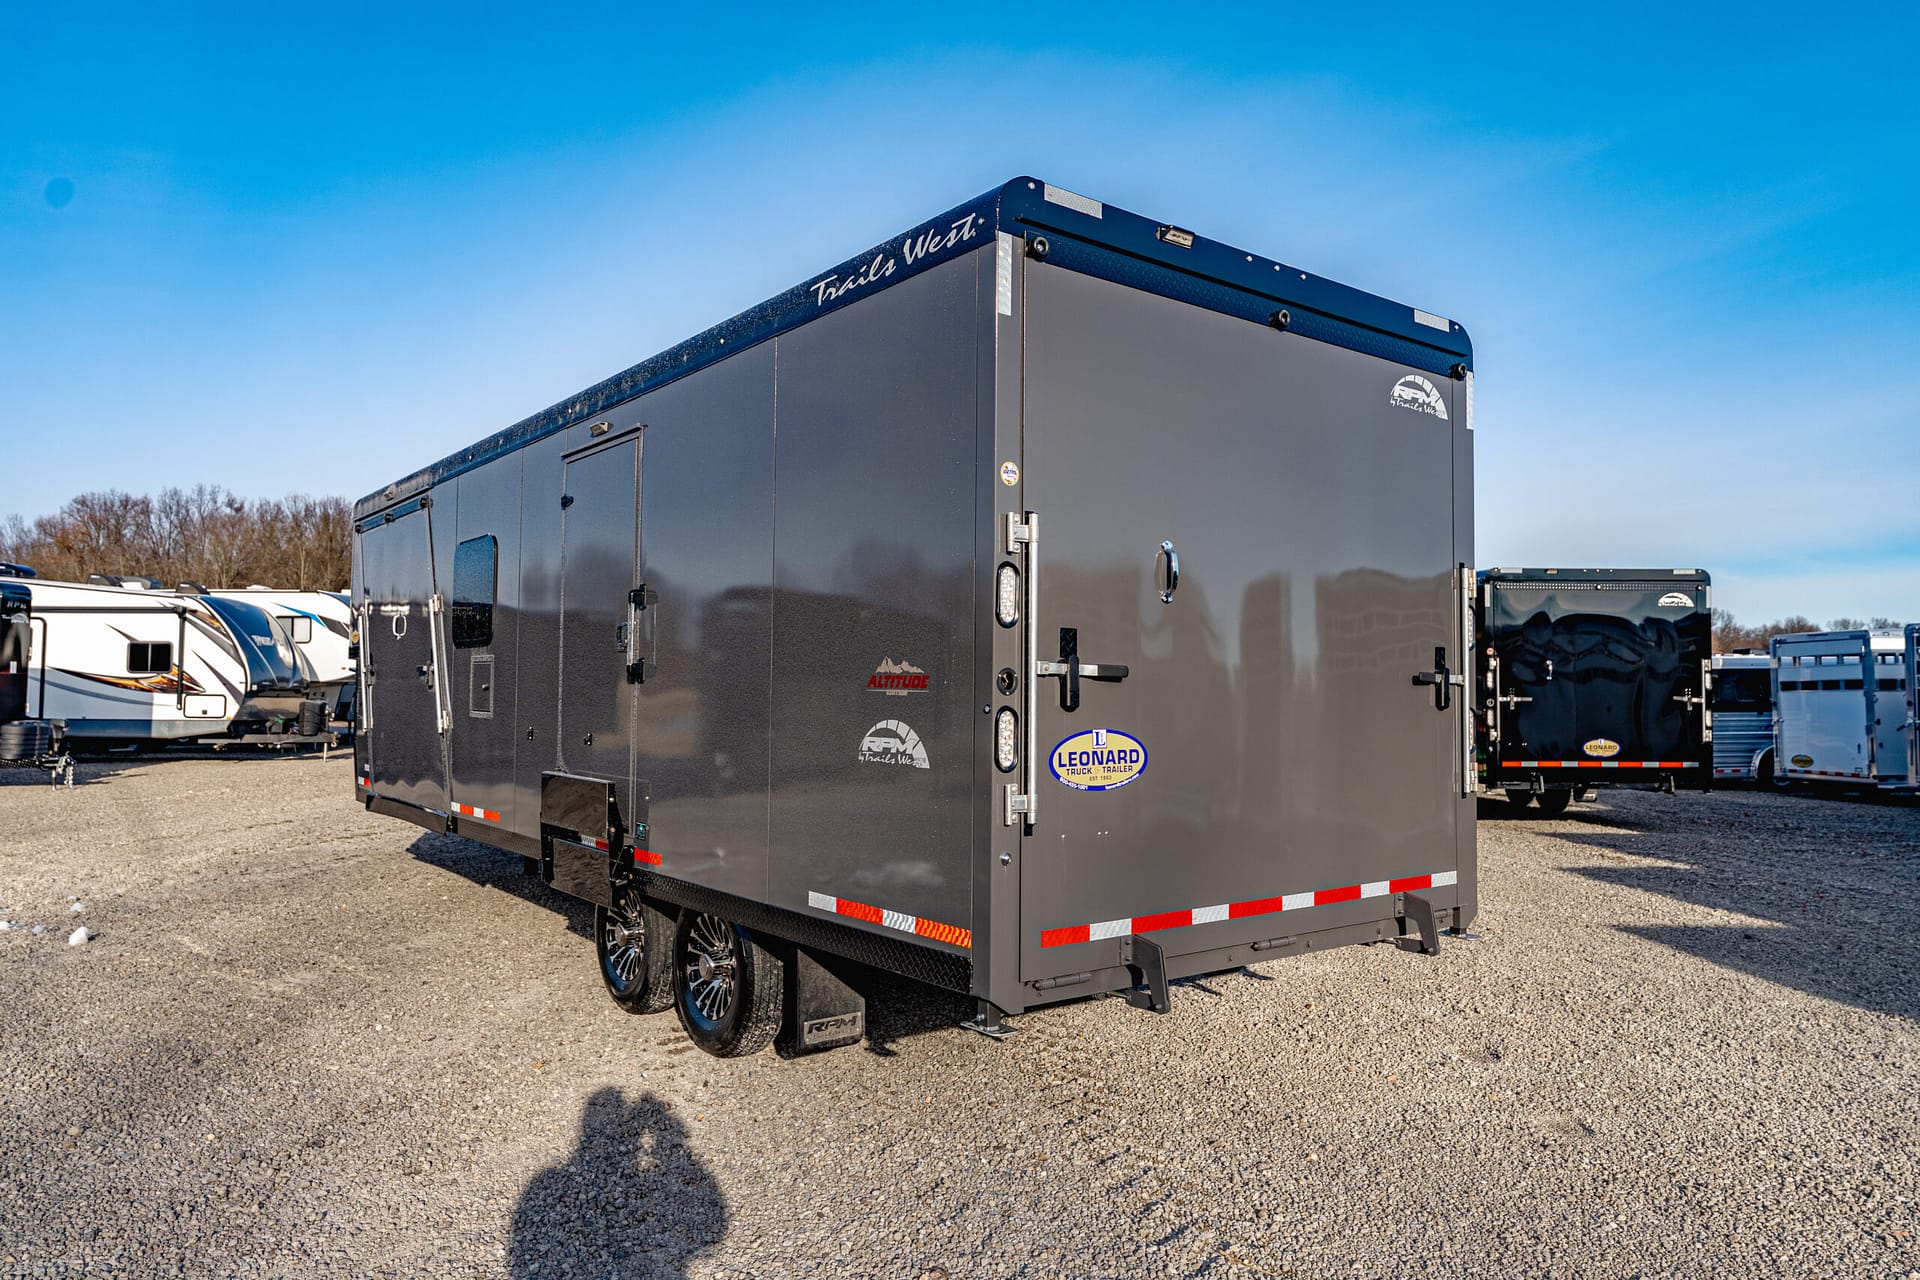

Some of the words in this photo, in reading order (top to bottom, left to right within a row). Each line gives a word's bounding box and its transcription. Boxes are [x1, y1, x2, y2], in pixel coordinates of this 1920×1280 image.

[810, 253, 896, 306] Trails
[1392, 385, 1440, 407] RPM
[1394, 397, 1423, 413] Trails
[866, 674, 931, 689] ALTITUDE
[862, 736, 919, 754] RPM
[862, 751, 895, 765] Trails
[1058, 749, 1140, 768] LEONARD
[1066, 767, 1092, 776] TRUCK
[1102, 765, 1133, 774] TRAILER
[807, 1015, 858, 1034] RPM
